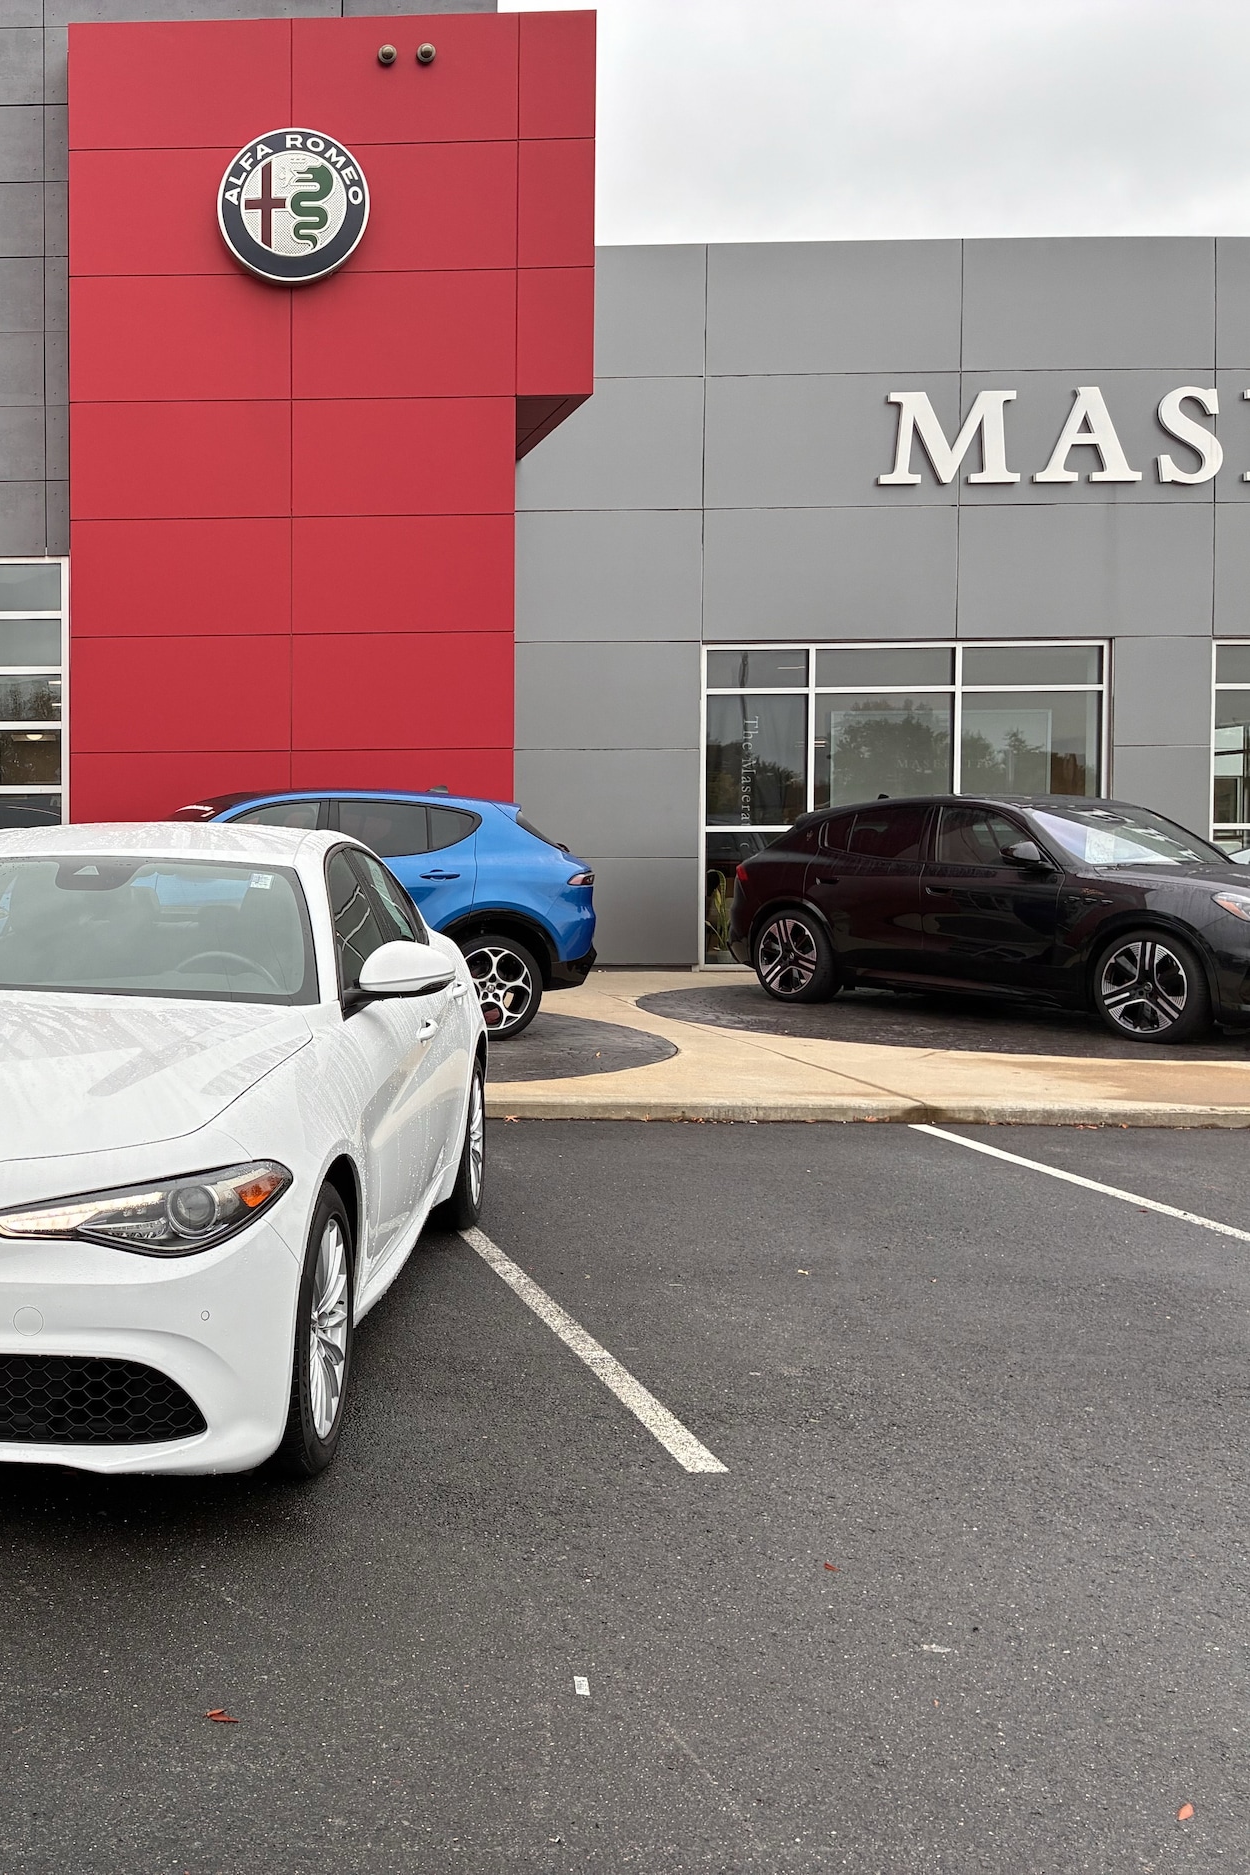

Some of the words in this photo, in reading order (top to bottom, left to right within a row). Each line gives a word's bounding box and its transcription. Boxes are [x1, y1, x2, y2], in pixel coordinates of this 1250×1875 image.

[224, 143, 274, 206] ALFA
[285, 134, 363, 205] ROMEO
[877, 386, 1250, 485] MAS
[741, 716, 759, 750] The
